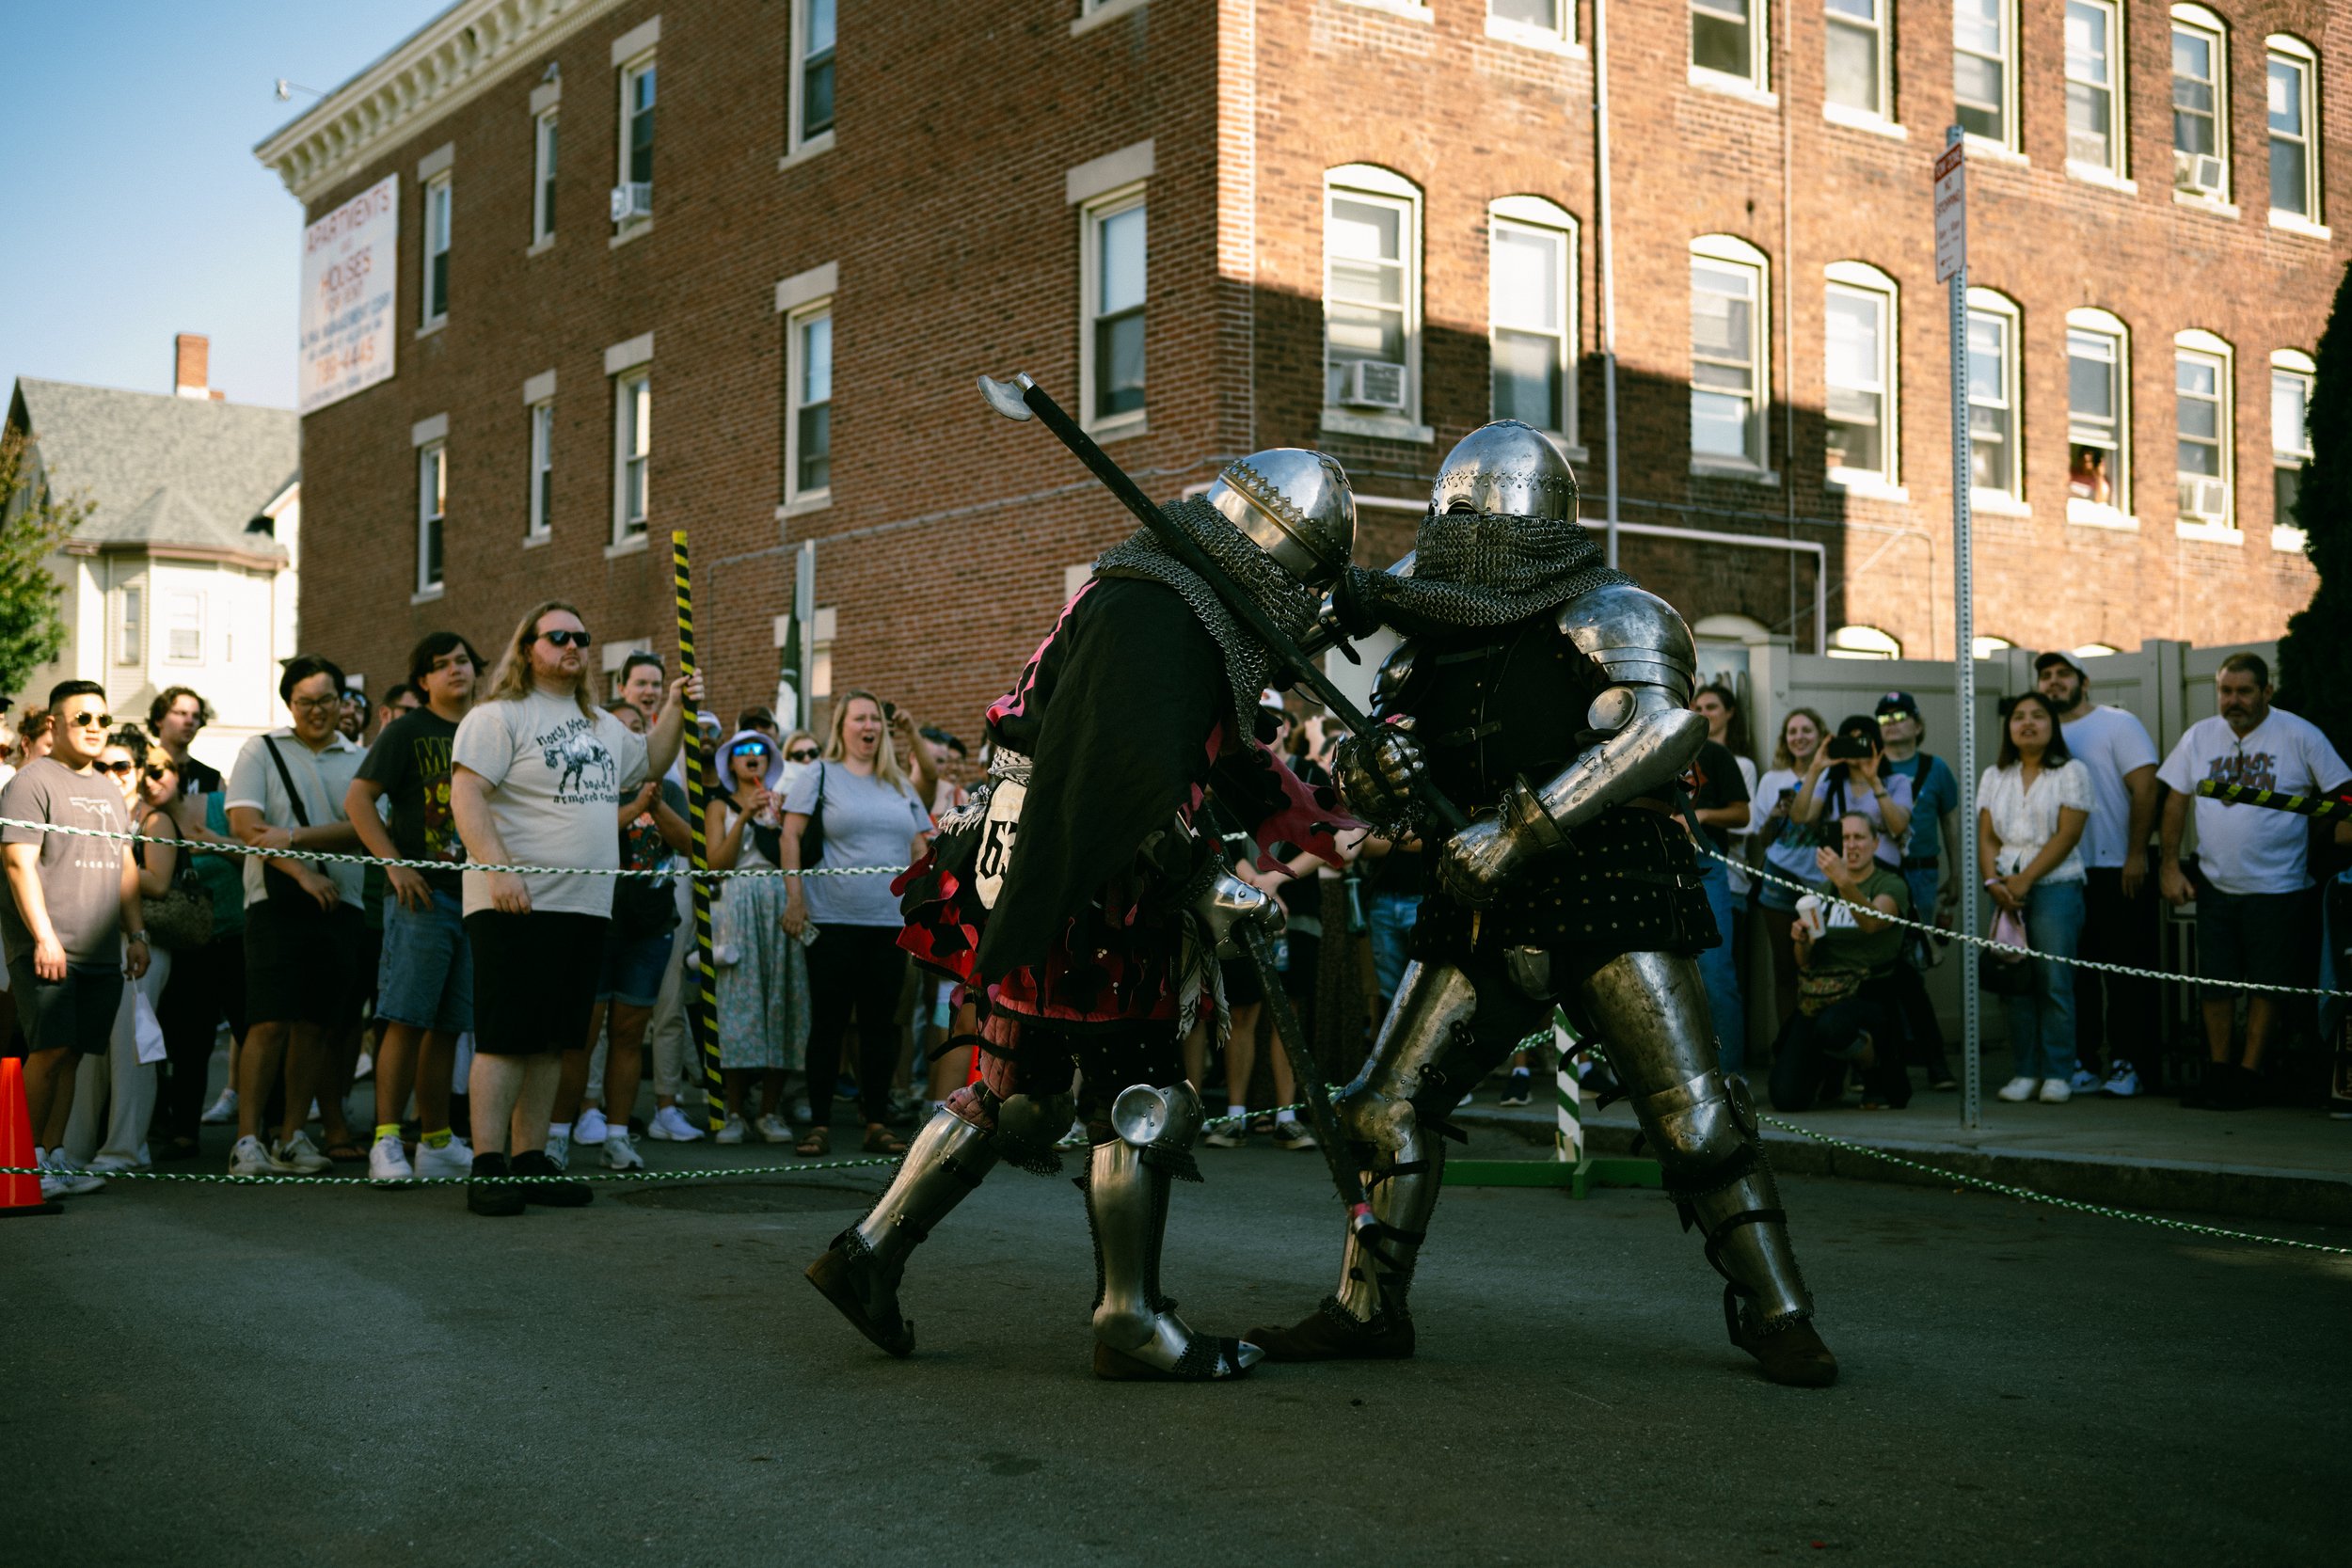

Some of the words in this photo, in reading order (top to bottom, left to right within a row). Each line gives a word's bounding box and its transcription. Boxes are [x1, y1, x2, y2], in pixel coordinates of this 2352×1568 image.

[306, 182, 390, 252] APARTMENTS
[319, 247, 371, 298] HOUSES
[536, 725, 566, 746] north
[583, 779, 612, 792] boston
[553, 791, 598, 805] armored
[600, 792, 620, 804] comb
